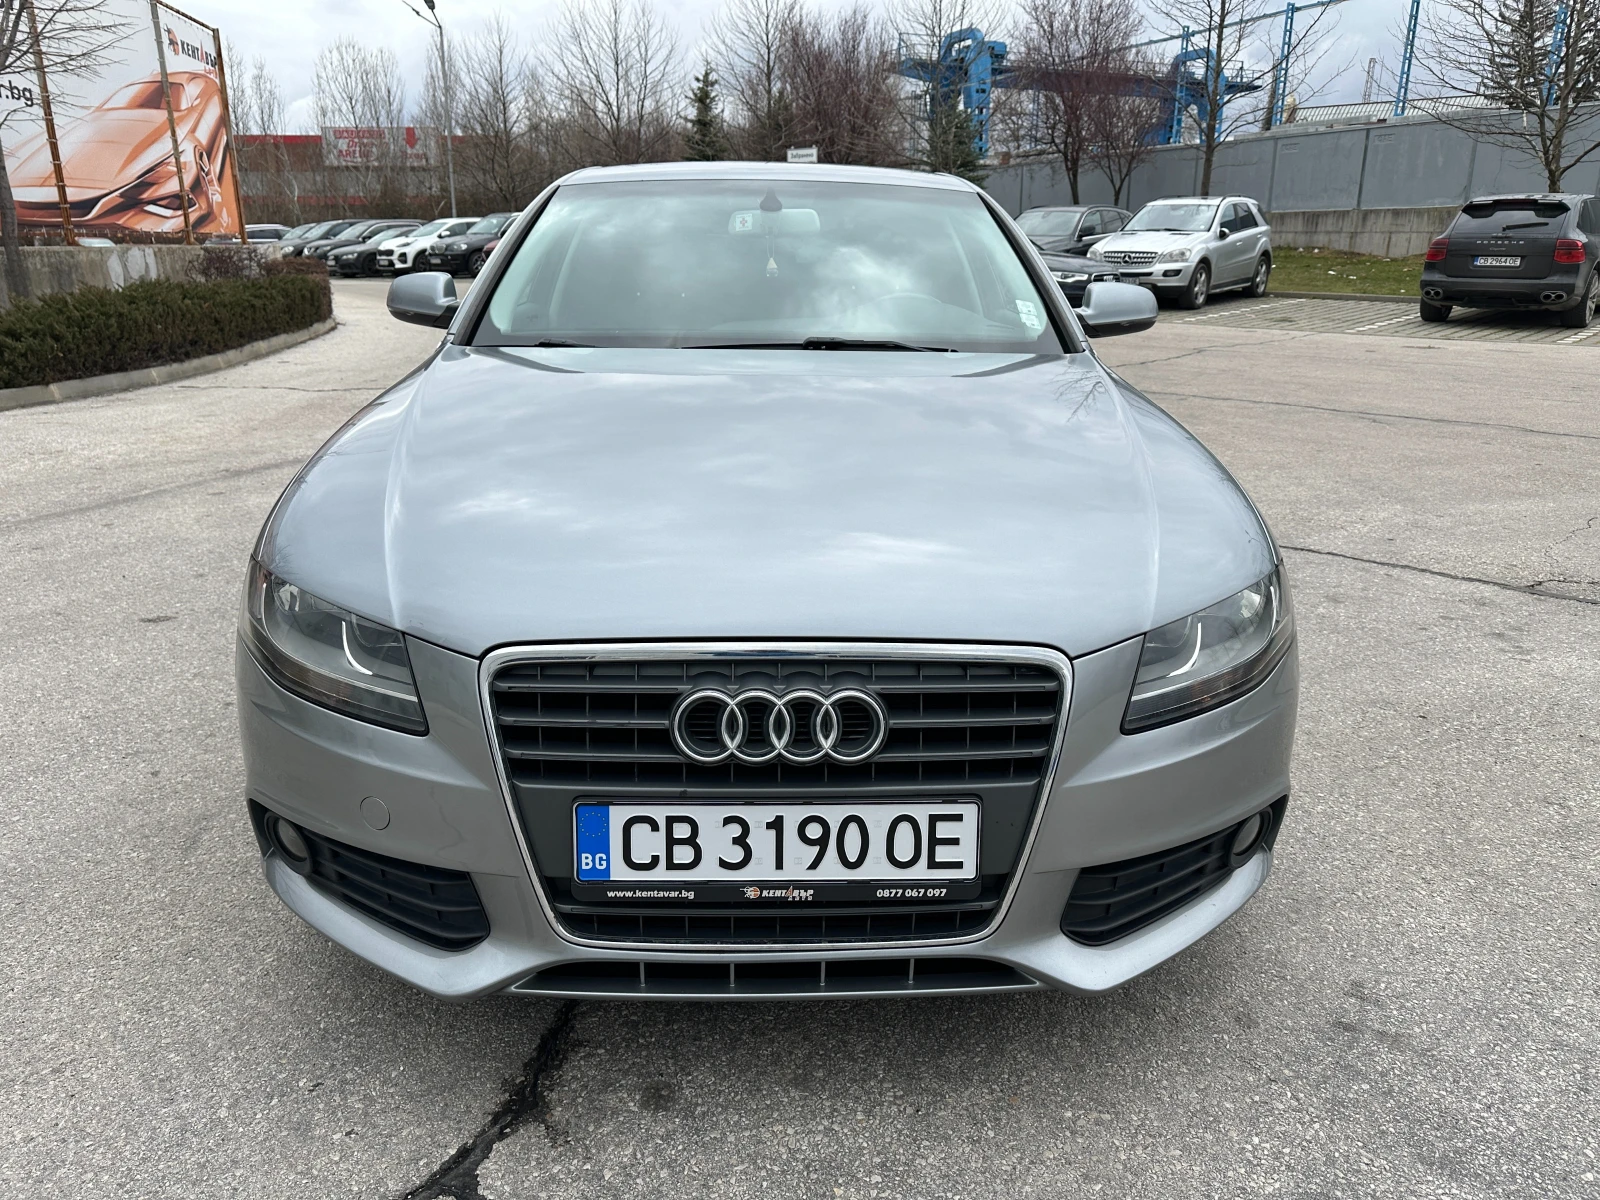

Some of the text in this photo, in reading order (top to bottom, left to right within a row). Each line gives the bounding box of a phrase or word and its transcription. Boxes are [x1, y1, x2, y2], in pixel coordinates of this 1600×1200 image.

[1490, 257, 1508, 265] 2964
[621, 814, 704, 872] CB
[718, 813, 870, 872] 3190
[581, 853, 607, 871] BG
[607, 889, 695, 900] www.kentavar.bg
[876, 888, 947, 898] 0877 067 097
